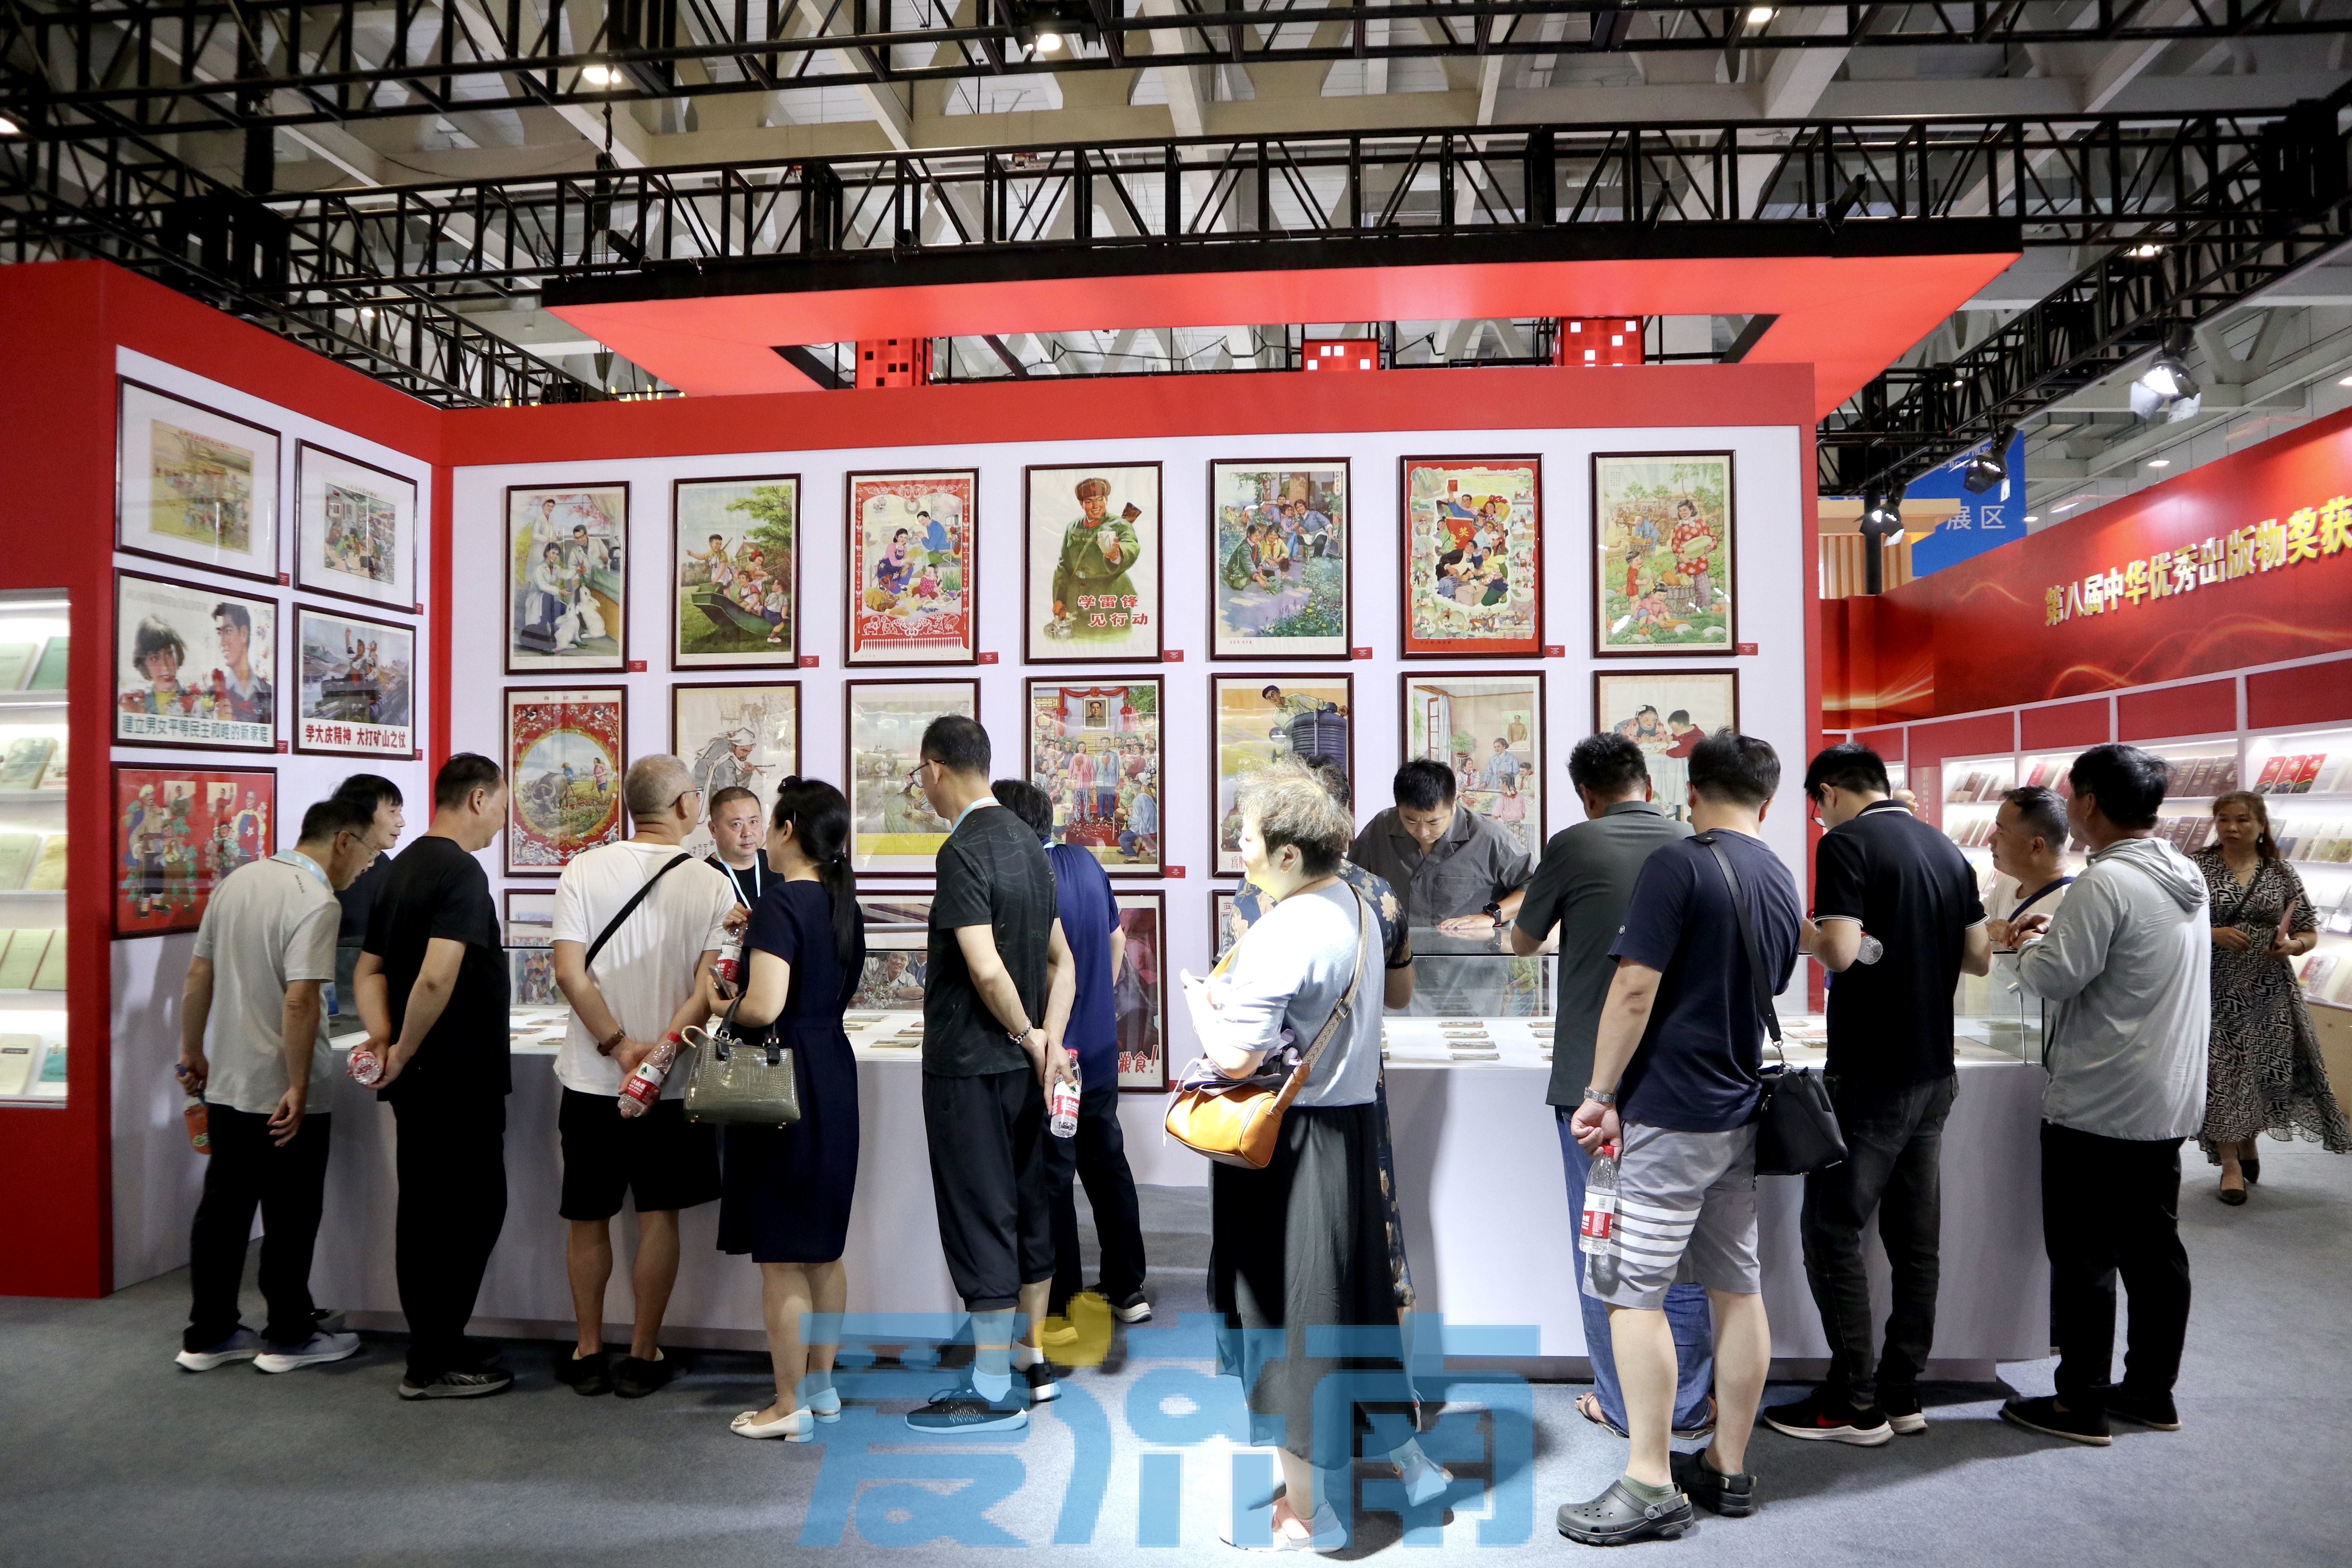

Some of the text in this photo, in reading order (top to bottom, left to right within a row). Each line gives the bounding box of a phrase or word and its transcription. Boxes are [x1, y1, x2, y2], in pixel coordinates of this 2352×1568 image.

[1946, 505, 2006, 530] 展区
[1458, 526, 1469, 537] 奖
[2044, 495, 2352, 626] 第八届中华优秀出版物奖获
[1077, 594, 1139, 609] 学雷锋
[1089, 612, 1149, 627] 见行动
[123, 715, 268, 742] 建立男女平等民主和睦的新家庭
[305, 724, 406, 748] 学大庆精神 大打矿山之仗
